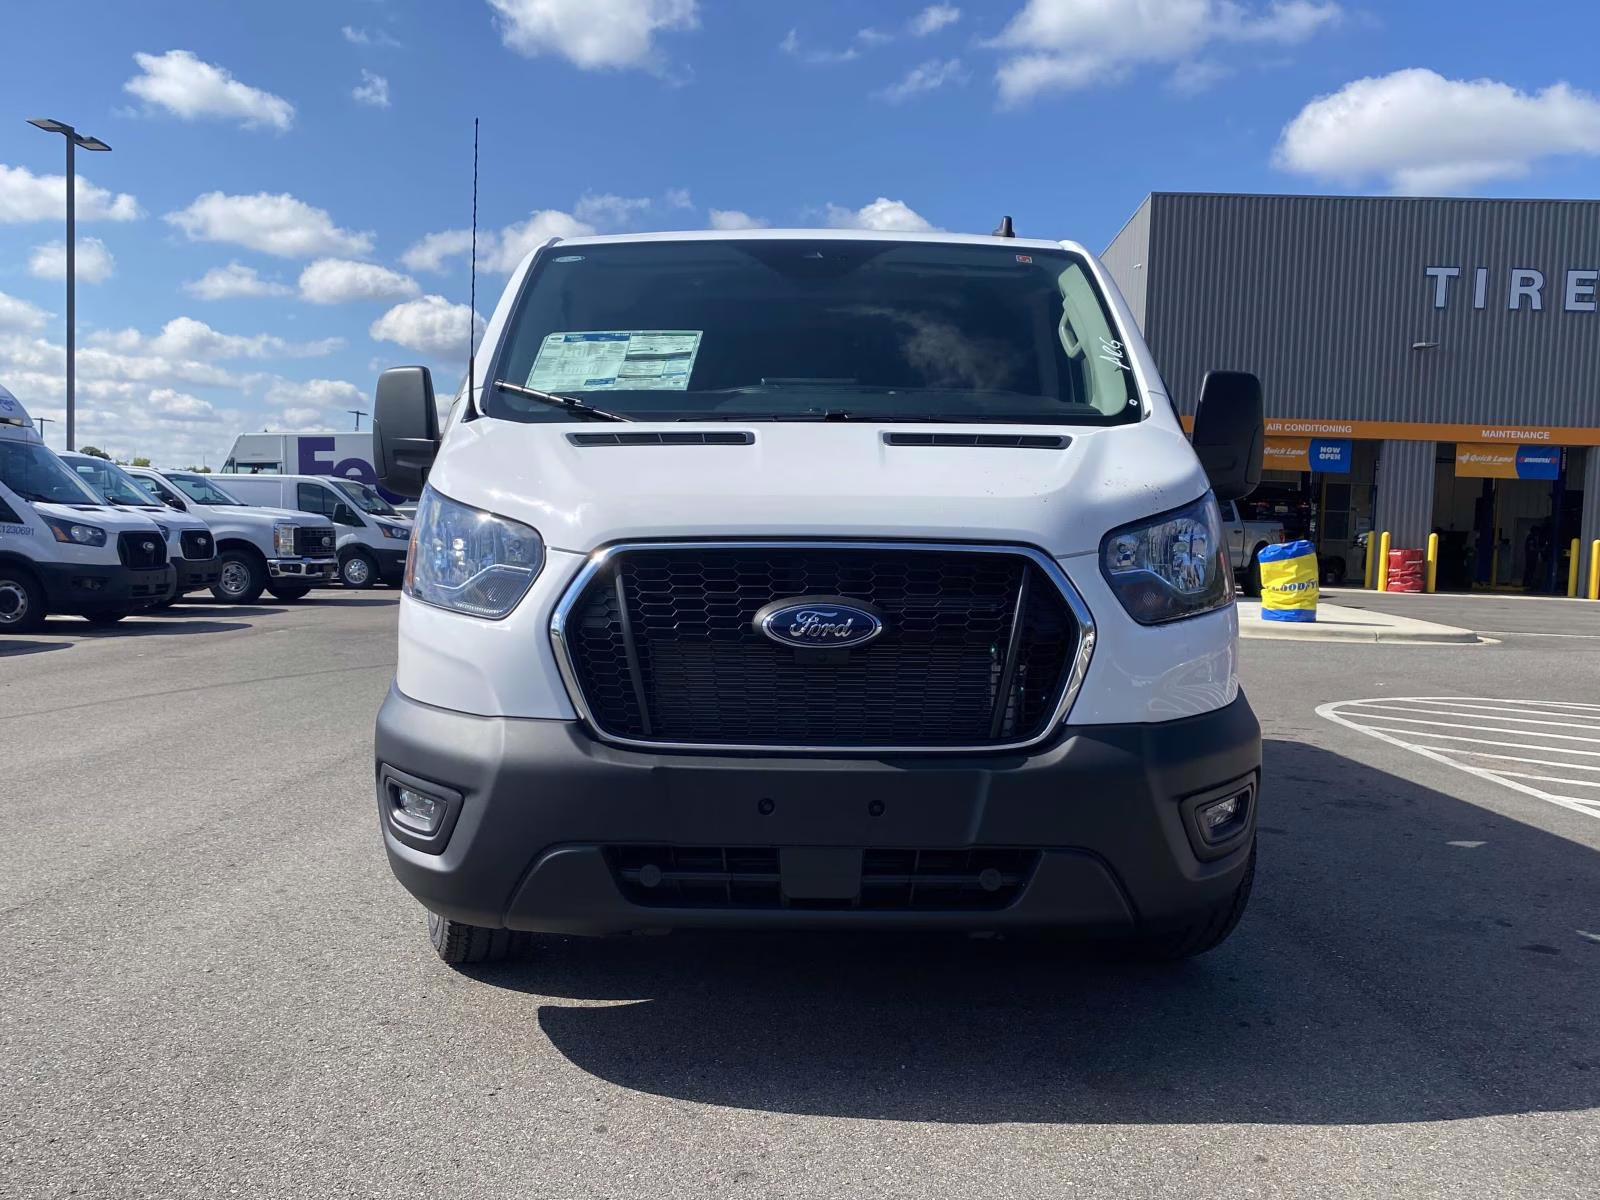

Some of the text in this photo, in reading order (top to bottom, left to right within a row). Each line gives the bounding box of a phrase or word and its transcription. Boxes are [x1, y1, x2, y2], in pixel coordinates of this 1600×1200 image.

[1426, 267, 1598, 311] TIRE
[1266, 423, 1352, 433] AIR CONDITIONING
[1481, 430, 1551, 440] MAINTENANCE
[1320, 446, 1341, 454] NOW
[0, 525, 34, 536] 1230691
[789, 610, 854, 638] Ford
